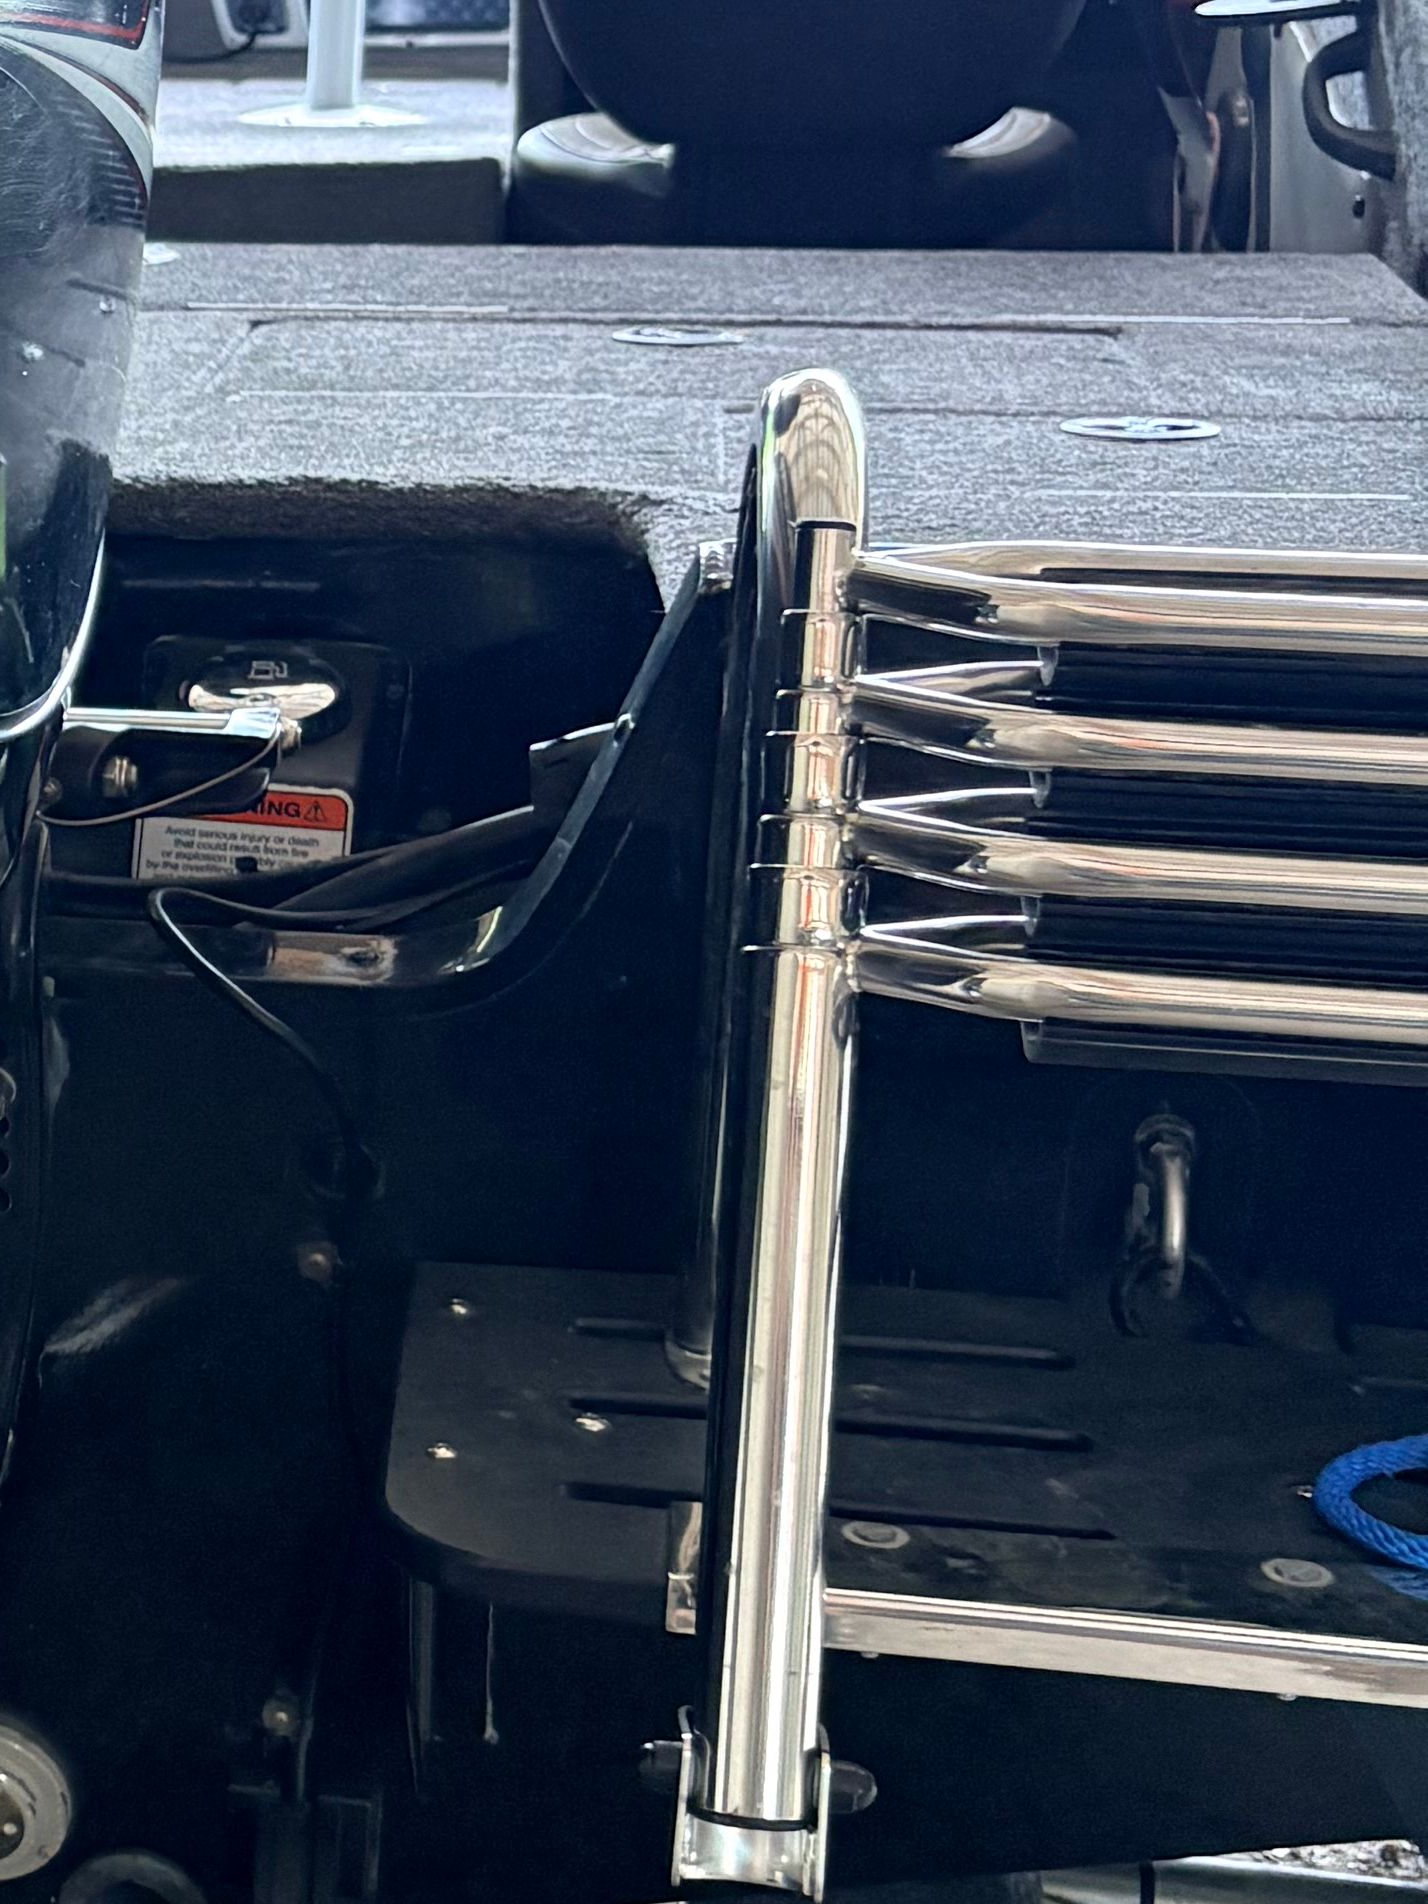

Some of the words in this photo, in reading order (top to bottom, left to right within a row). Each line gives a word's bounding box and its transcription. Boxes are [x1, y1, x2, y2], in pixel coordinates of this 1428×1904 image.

[165, 825, 195, 838] Avoid
[198, 829, 238, 840] serious
[240, 831, 270, 844] injury
[273, 835, 285, 844] or
[288, 834, 320, 847] death
[174, 838, 194, 848] that
[196, 840, 227, 851] could
[263, 844, 289, 856] from
[291, 847, 309, 858] fire
[162, 860, 179, 871] the
[175, 851, 227, 864] explosion
